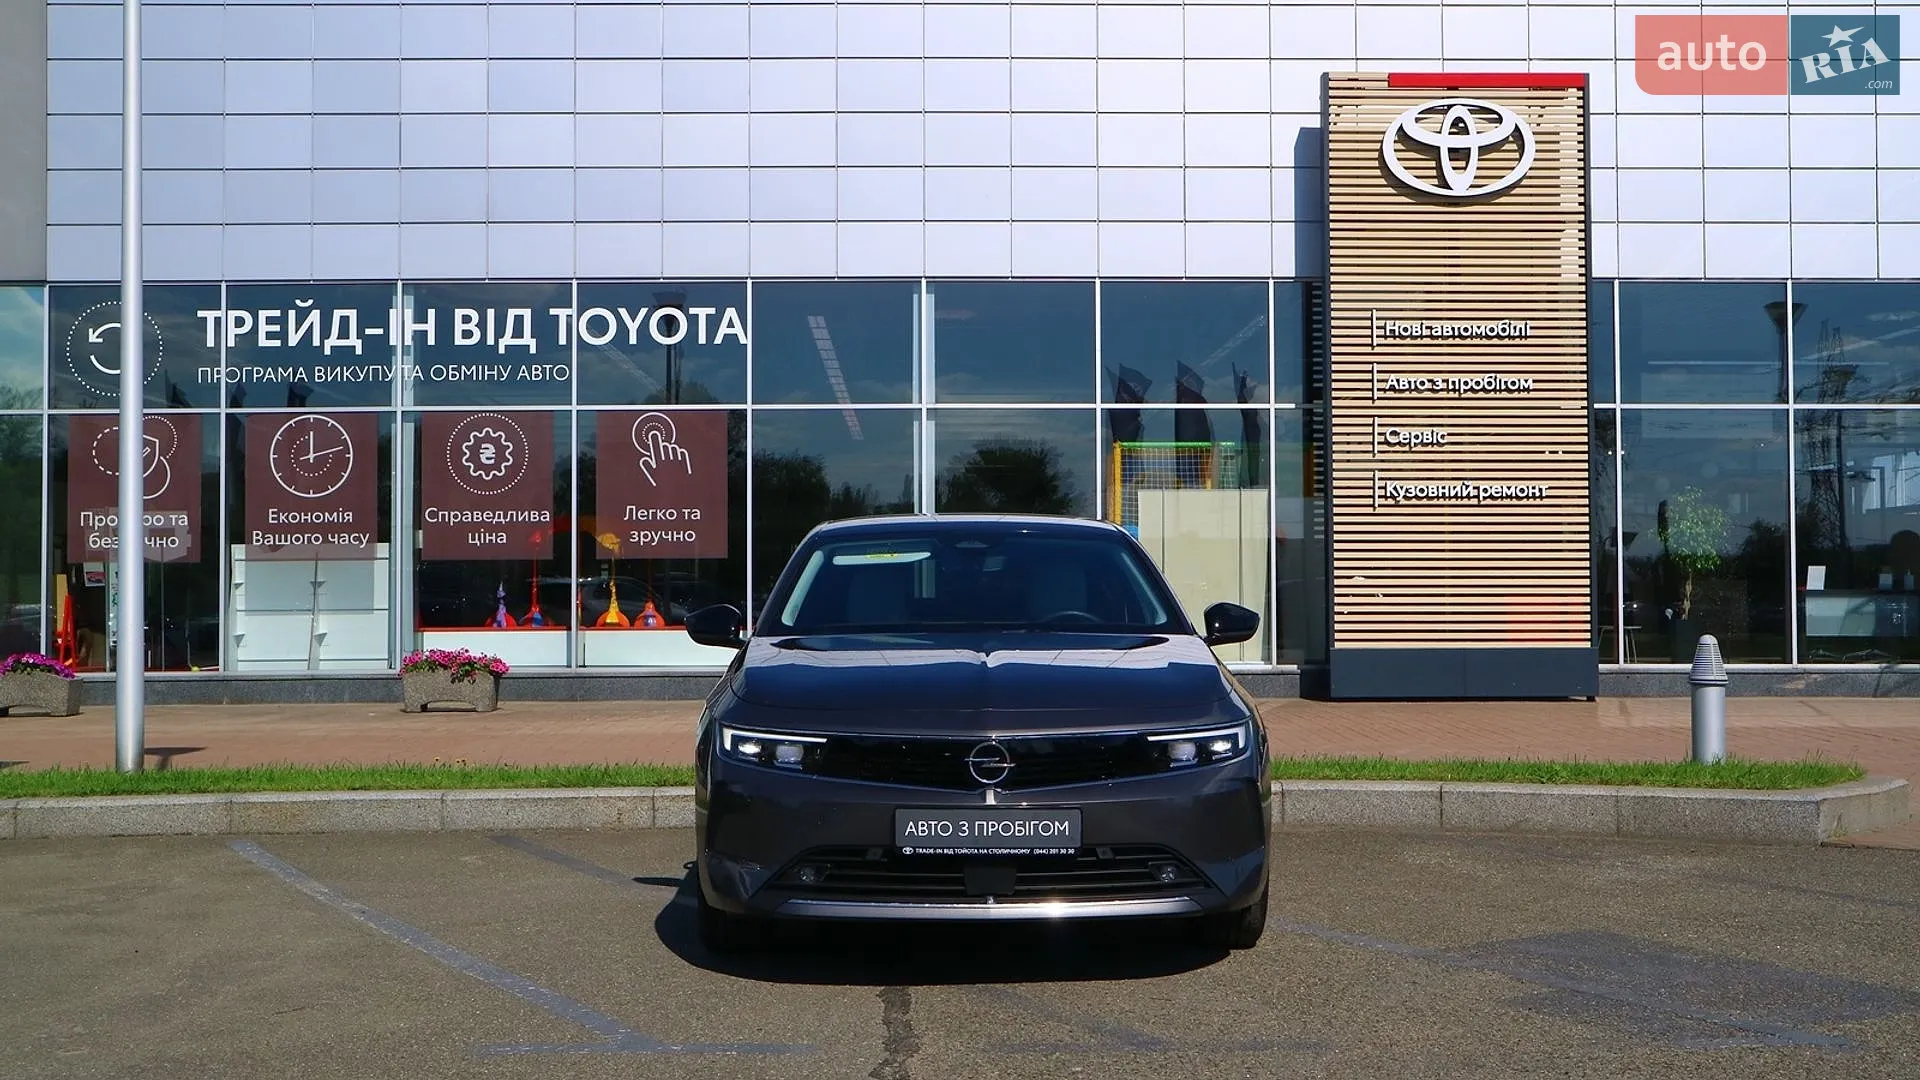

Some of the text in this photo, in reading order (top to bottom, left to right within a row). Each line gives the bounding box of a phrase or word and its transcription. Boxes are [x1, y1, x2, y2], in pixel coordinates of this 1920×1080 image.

[197, 299, 748, 355] ТРЕЙД-ІН ВІД TOYOTA
[1385, 320, 1530, 337] Нові автомобілі
[198, 364, 569, 383] ПРОГРАМА ВИКУПУ ТА ОБМІНУ АВТО
[1385, 373, 1533, 394] Авто з пробігом
[1386, 428, 1448, 447] Сервіс
[1386, 481, 1549, 501] Кузовний ремонт
[170, 514, 188, 526] та
[268, 508, 353, 524] Економія
[425, 507, 550, 526] Справедлива
[623, 506, 701, 521] Легко та
[89, 532, 179, 548] безчно
[252, 531, 370, 548] Вашого часу
[468, 529, 507, 545] ціна
[629, 530, 696, 546] зручно
[904, 820, 953, 837] АВТО
[974, 819, 1070, 837] ПРОБІГОМ
[915, 847, 943, 855] TRADE-IN
[954, 847, 978, 855] ТОЙОТА
[1033, 847, 1048, 855] (044)
